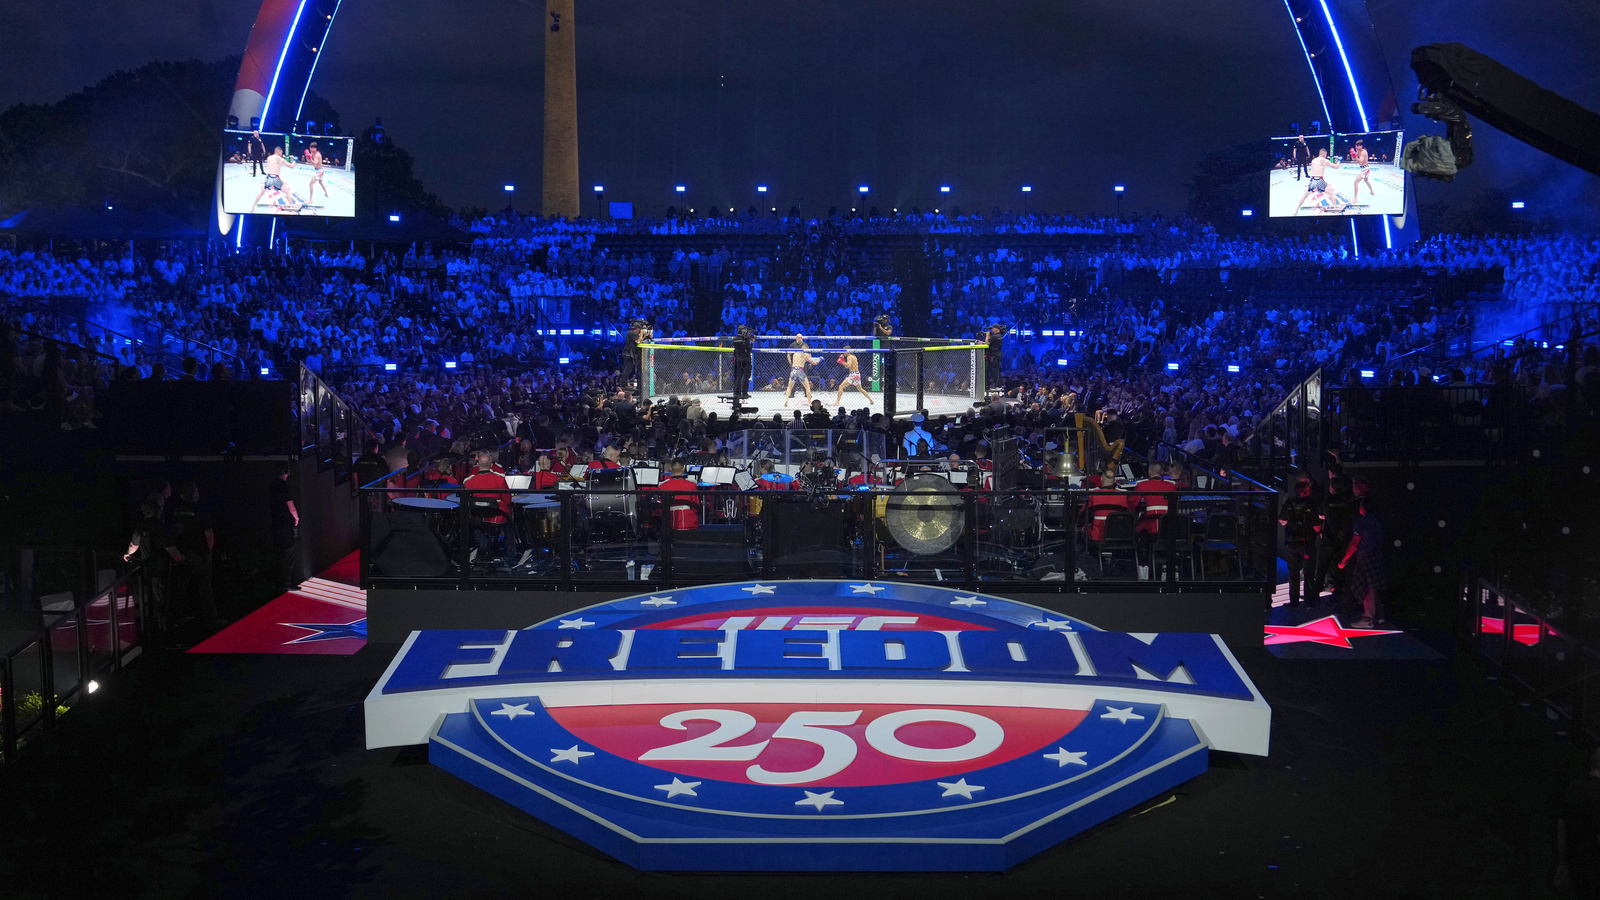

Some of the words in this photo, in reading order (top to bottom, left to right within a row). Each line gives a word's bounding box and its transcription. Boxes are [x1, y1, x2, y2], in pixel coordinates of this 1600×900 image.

[872, 353, 880, 377] Scotts
[382, 629, 1254, 699] FREEDOM
[638, 709, 1004, 784] 250
